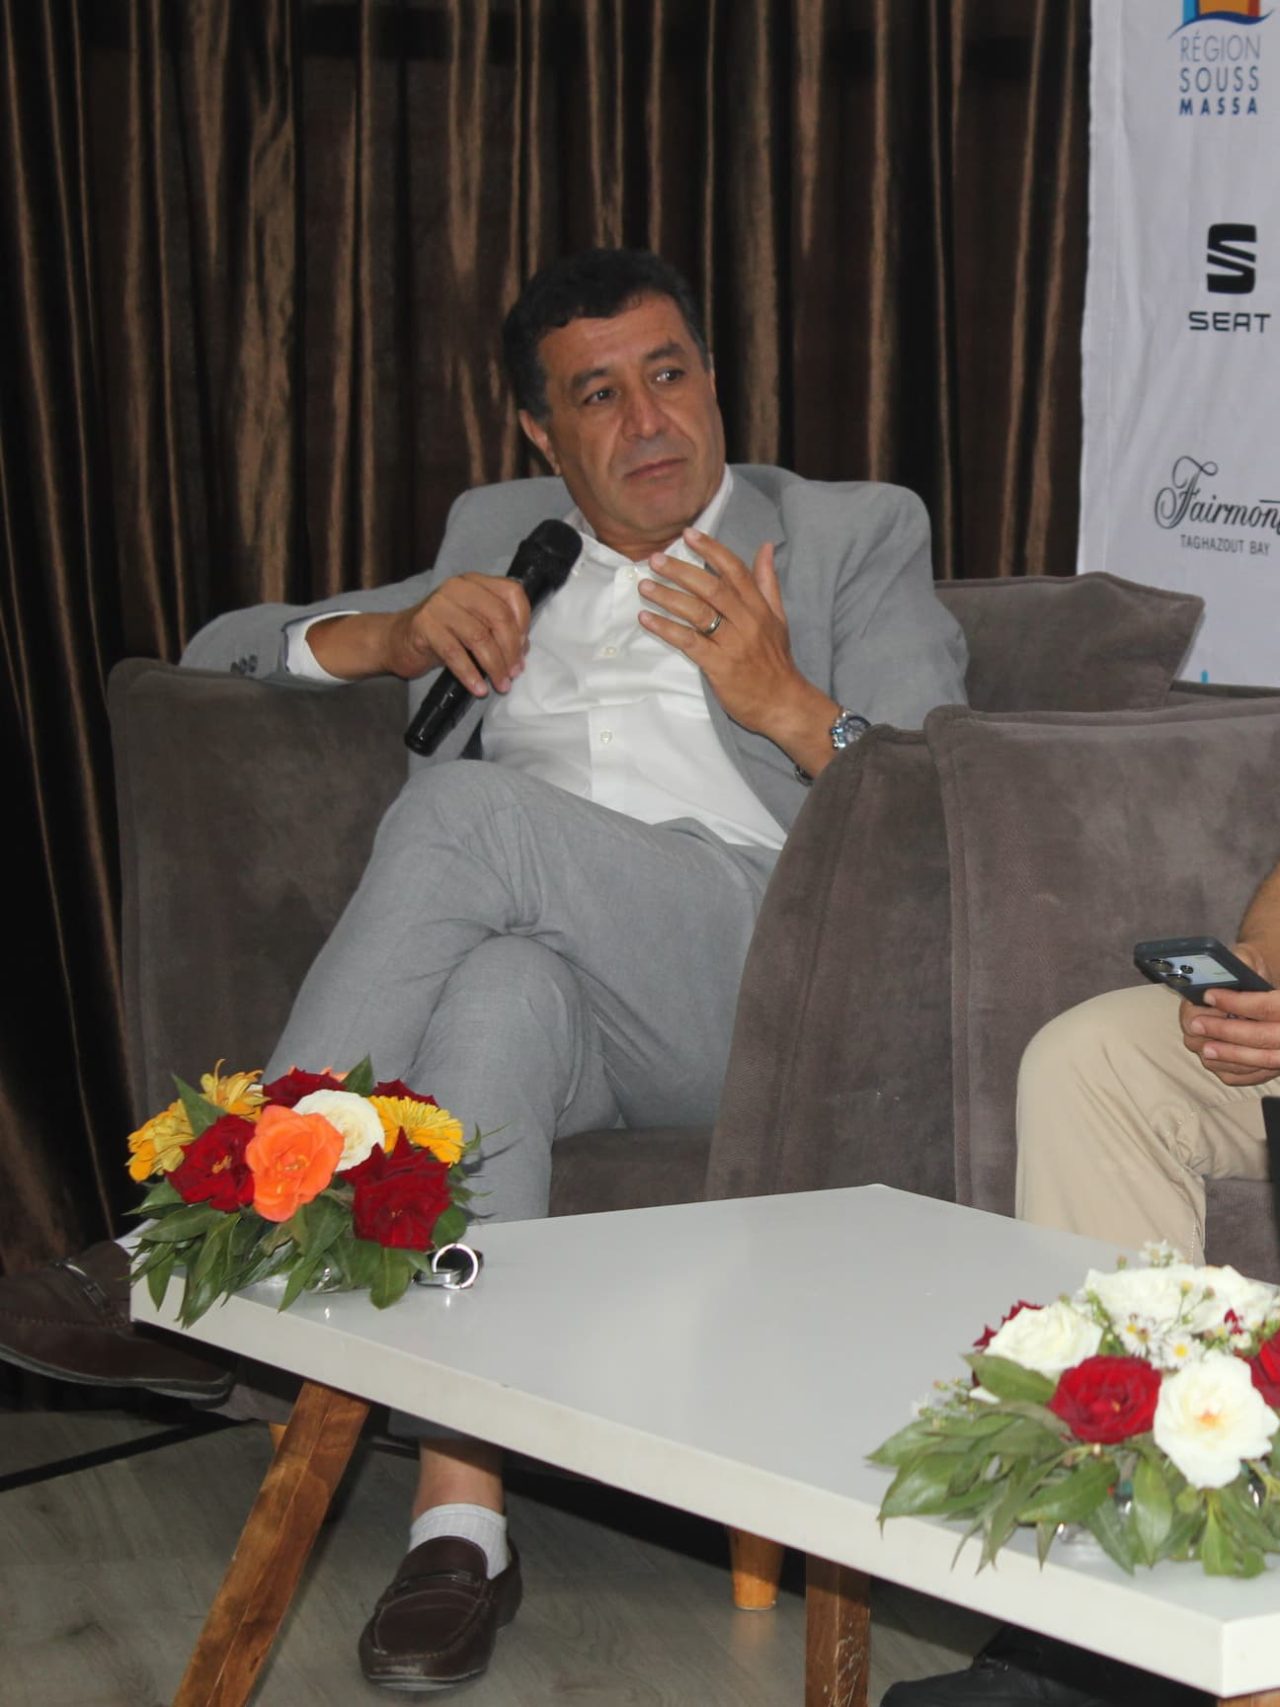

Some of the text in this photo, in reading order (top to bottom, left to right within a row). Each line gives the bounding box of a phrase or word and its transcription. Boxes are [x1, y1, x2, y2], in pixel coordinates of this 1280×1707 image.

[1180, 29, 1262, 62] RÉGION
[1179, 65, 1260, 93] SOUSS
[1179, 97, 1258, 116] MASSA
[1187, 310, 1272, 334] SEAT
[1180, 534, 1271, 556] TAGHAZOUT BAY
